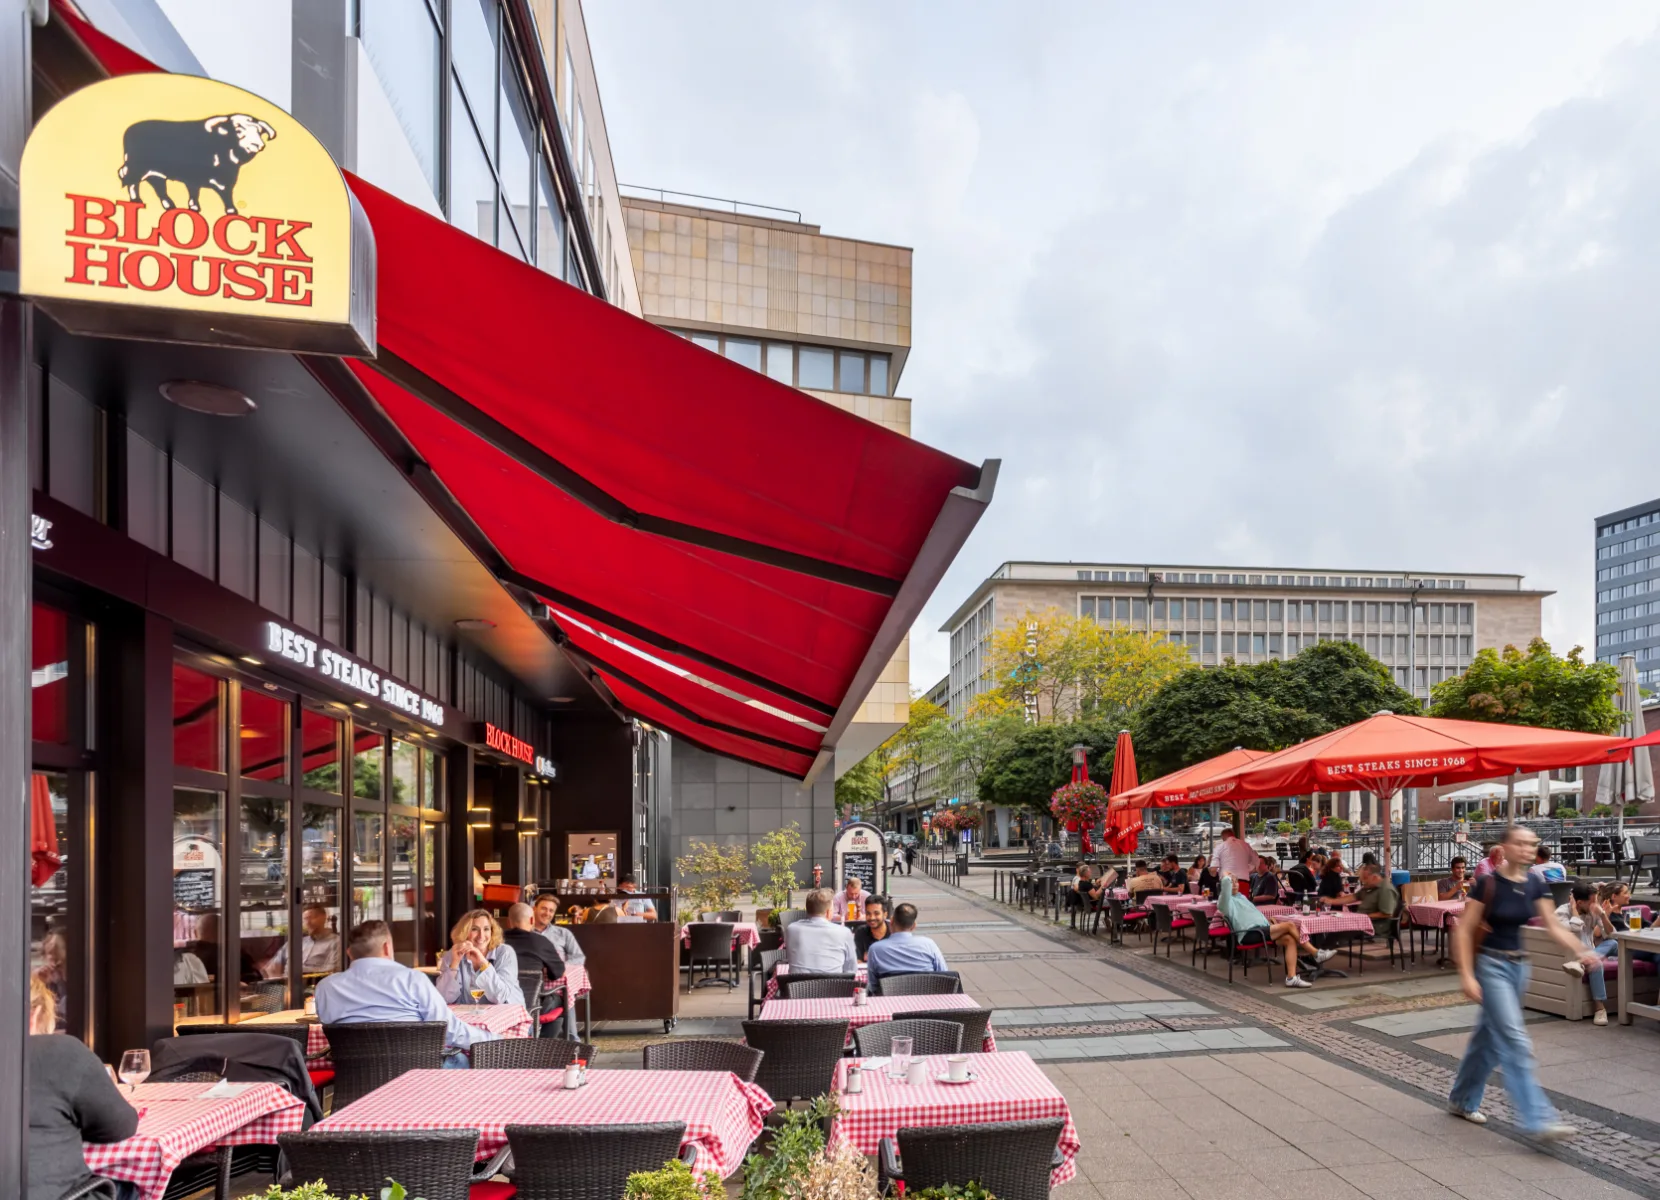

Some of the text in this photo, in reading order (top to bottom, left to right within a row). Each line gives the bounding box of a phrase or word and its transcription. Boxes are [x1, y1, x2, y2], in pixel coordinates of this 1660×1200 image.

[65, 192, 313, 263] BLOCK
[65, 240, 313, 308] HOUSE
[268, 621, 445, 727] BEST STEAKS SINCE 1968
[486, 722, 534, 765] BLOCK HOUSE
[1327, 757, 1466, 775] BEST STEAKS SINCE 1968
[1164, 793, 1185, 802] BEST
